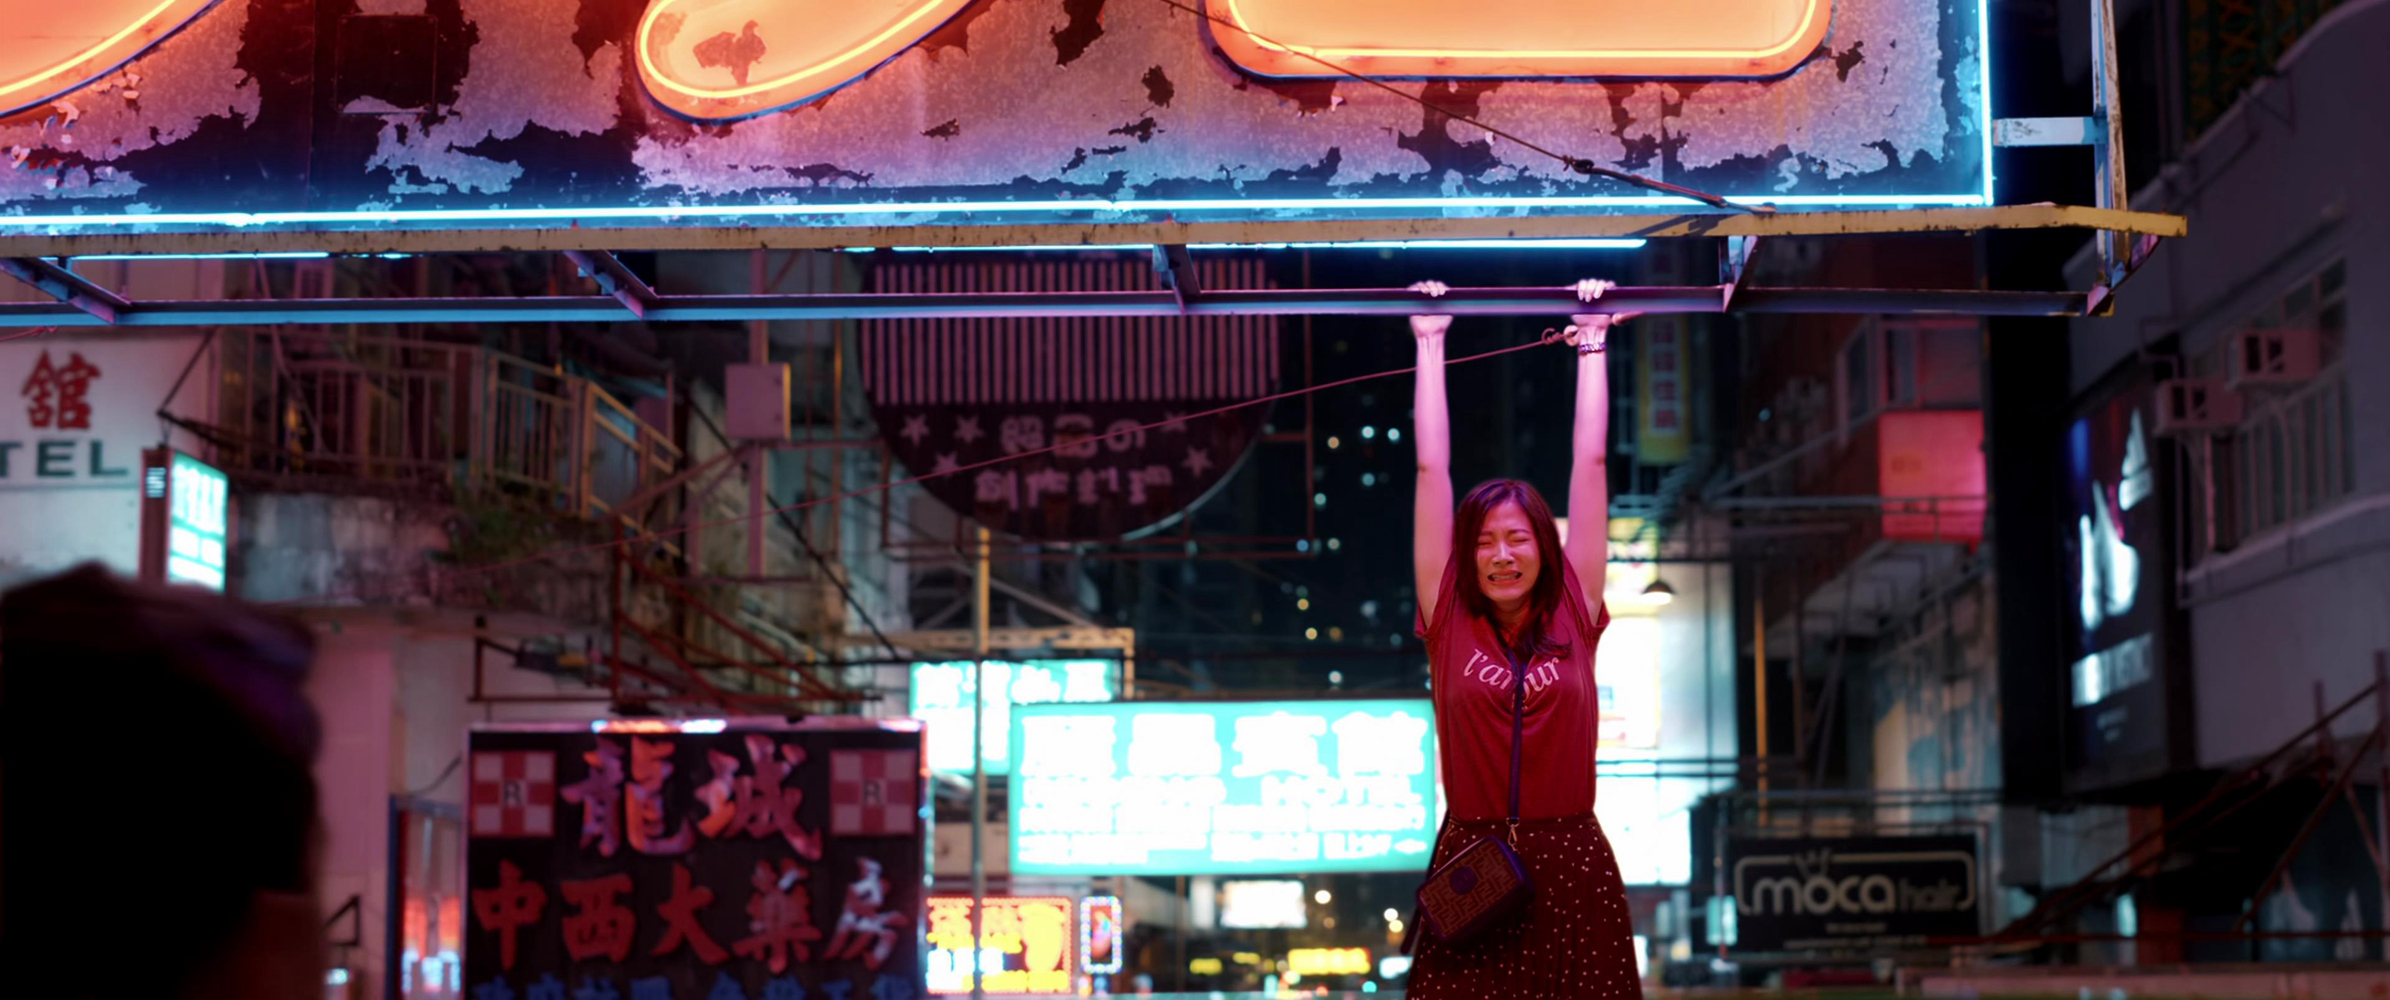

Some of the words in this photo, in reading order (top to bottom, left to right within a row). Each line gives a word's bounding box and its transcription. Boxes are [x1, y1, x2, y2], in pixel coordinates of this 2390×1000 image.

[1463, 648, 1560, 700] l'aur
[560, 734, 823, 861] 龍城
[472, 857, 908, 975] 中西大藥房
[1753, 874, 1896, 916] moca
